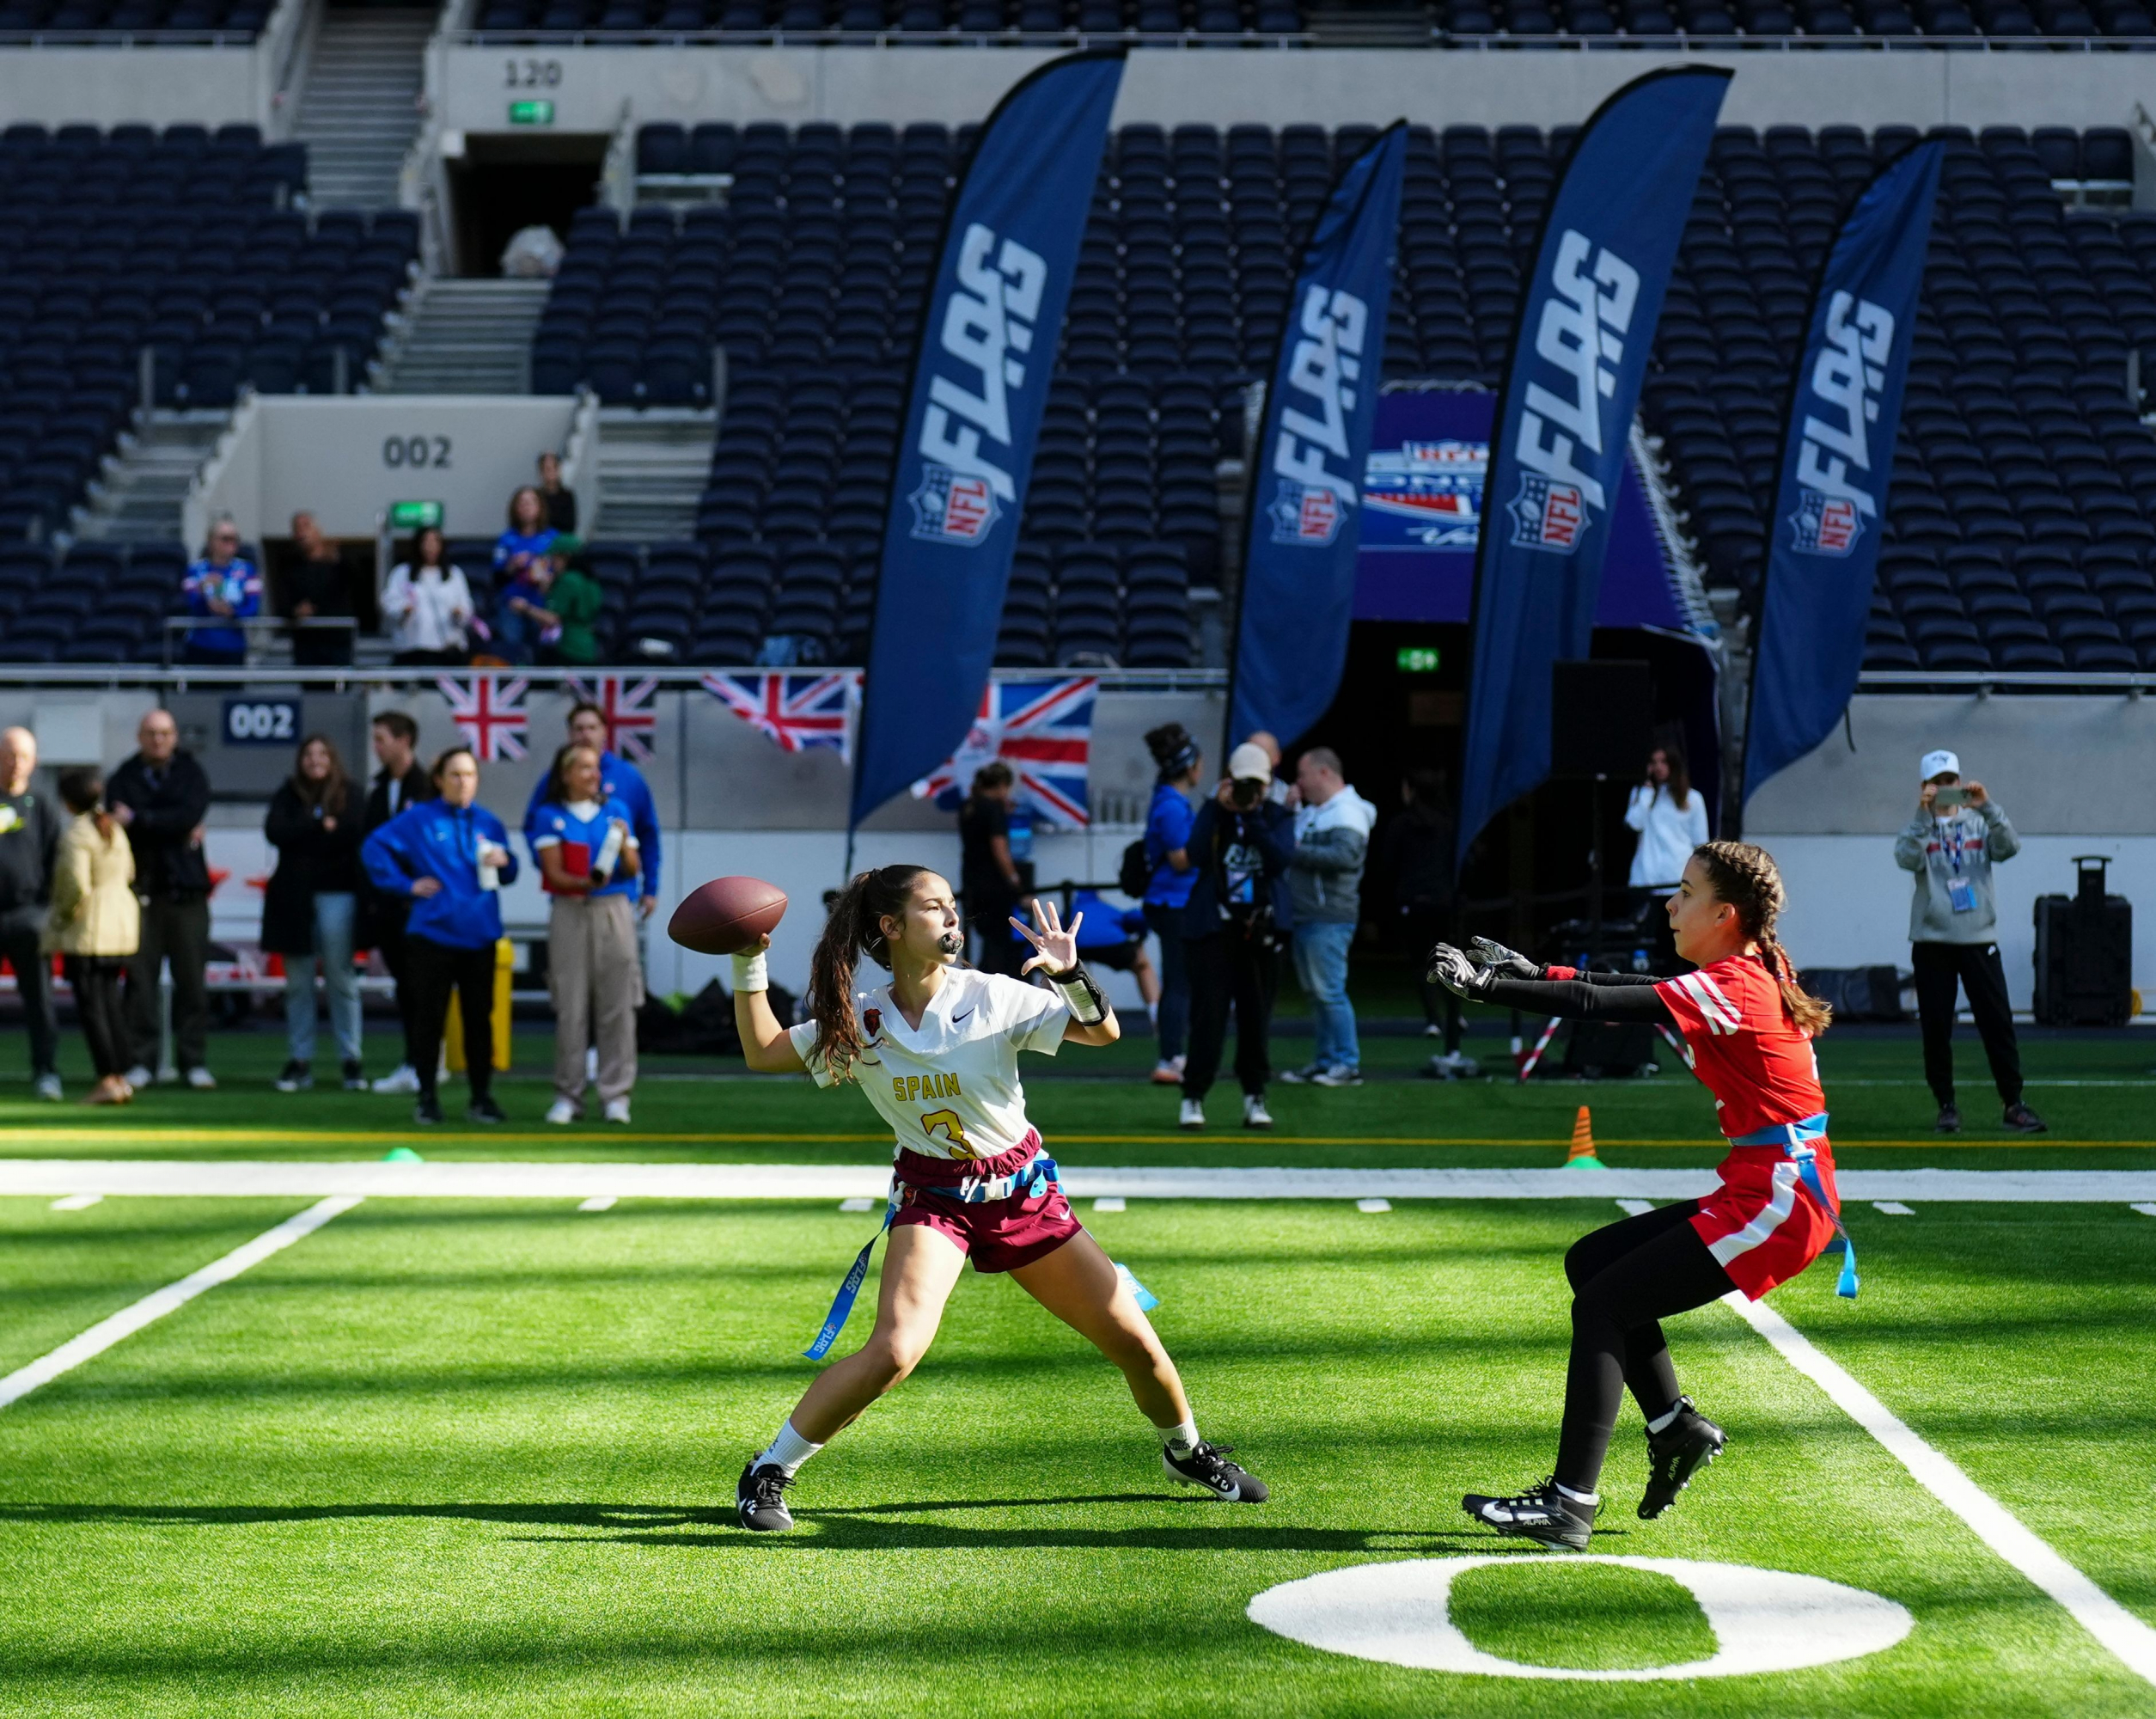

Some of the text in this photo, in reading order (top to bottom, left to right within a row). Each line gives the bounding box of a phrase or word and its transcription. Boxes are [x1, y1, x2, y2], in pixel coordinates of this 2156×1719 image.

[505, 58, 563, 88] 120
[918, 223, 1048, 536] NFL FLAG
[1515, 228, 1640, 544] NFL FLAG
[1273, 283, 1369, 538] NFL FLAG
[1796, 289, 1895, 551] NFL FLAG
[383, 436, 453, 468] 002
[229, 704, 294, 739] 002
[892, 1073, 962, 1102] SPAIN
[920, 1109, 978, 1160] 3
[813, 1325, 836, 1353] FLAG
[1668, 1456, 1681, 1481] ALPHA
